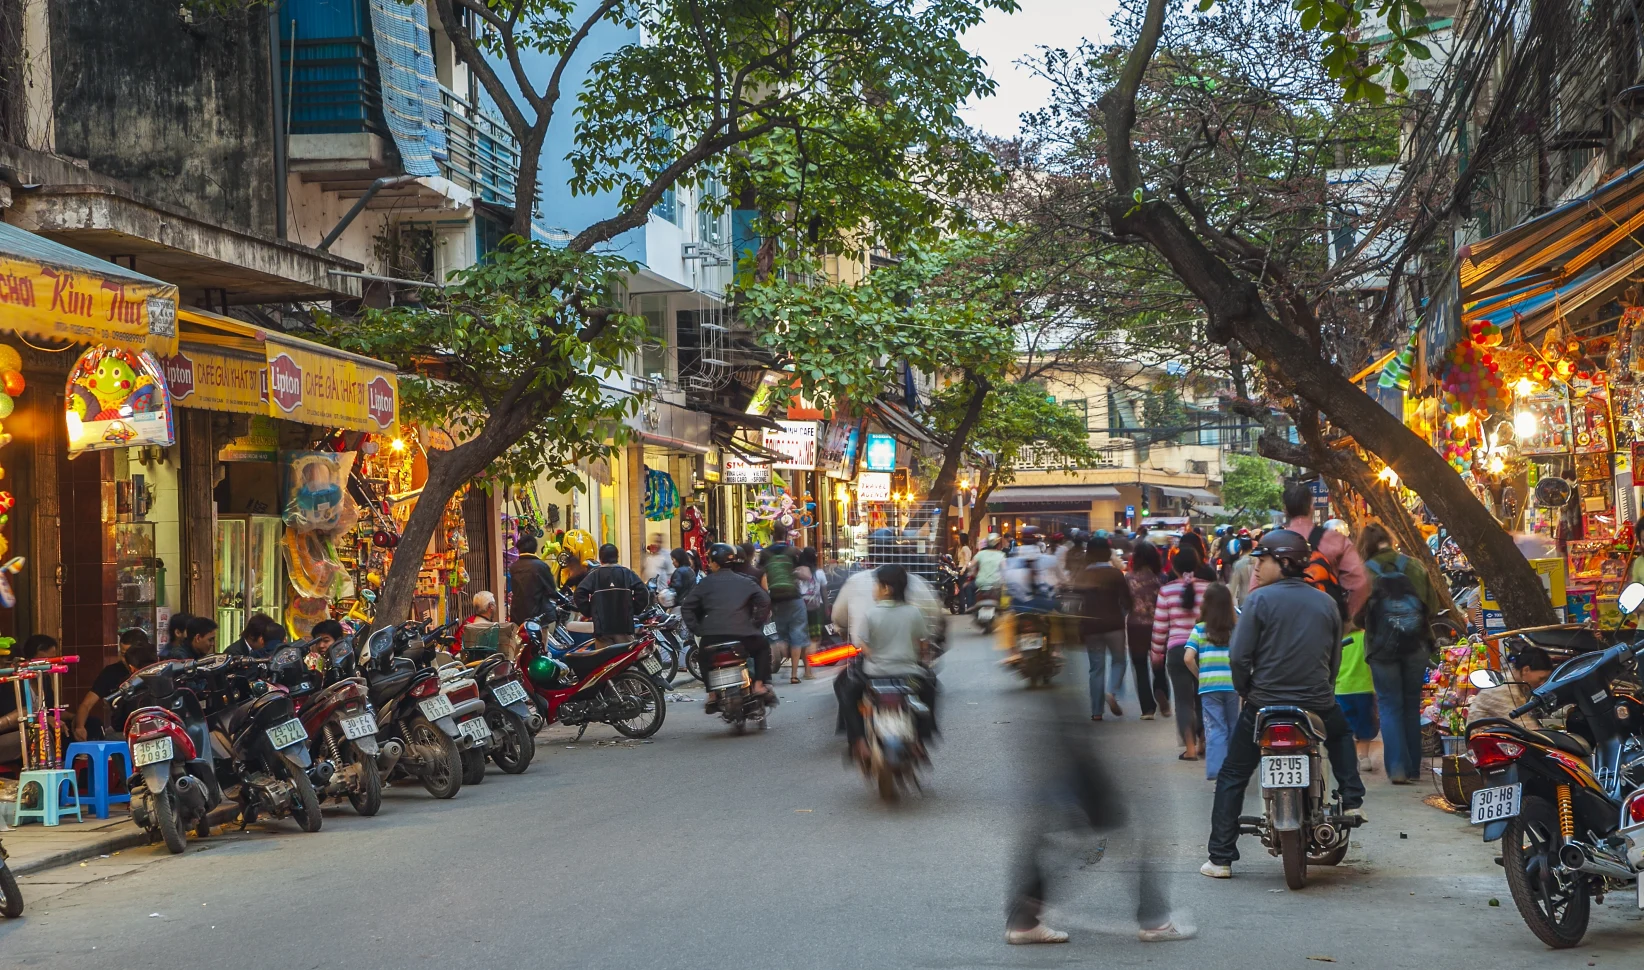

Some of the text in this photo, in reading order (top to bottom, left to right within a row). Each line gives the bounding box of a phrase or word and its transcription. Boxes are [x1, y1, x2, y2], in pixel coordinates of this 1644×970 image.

[40, 267, 94, 318] Kim
[197, 358, 215, 386] CAFÉ
[271, 366, 300, 399] Lipton
[305, 366, 325, 397] CAFÉ
[370, 387, 393, 417] Lipton
[784, 427, 814, 437] INH CAFE
[726, 461, 745, 469] SIM
[429, 705, 451, 719] 1029
[349, 725, 373, 737] 5160
[140, 740, 167, 753] 16-K7
[141, 750, 168, 764] 2093
[1269, 758, 1302, 771] 29-U5
[1270, 771, 1302, 785] 1233
[1479, 787, 1513, 805] 30-H8
[1478, 802, 1512, 820] 0683
